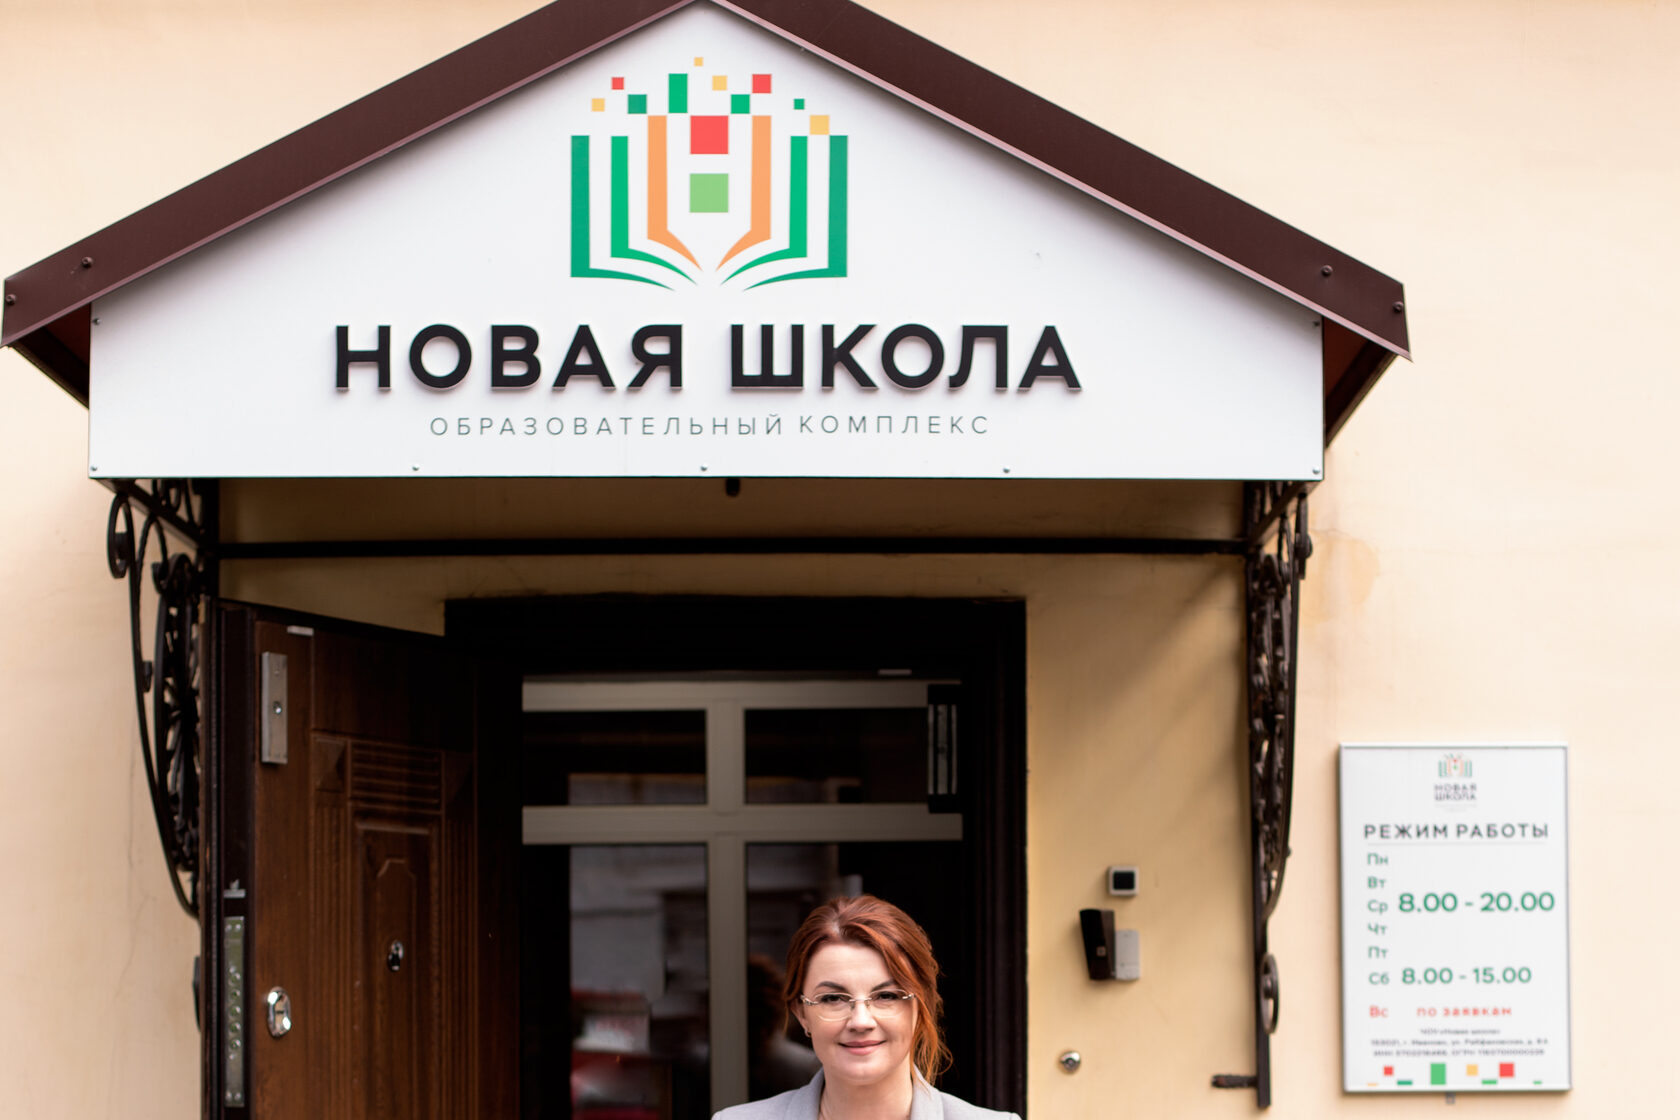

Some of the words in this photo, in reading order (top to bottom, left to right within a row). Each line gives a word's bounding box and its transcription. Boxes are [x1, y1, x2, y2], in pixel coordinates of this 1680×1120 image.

[335, 323, 683, 391] НОВАЯ
[730, 323, 1082, 391] ШКОЛА
[429, 413, 782, 437] ОБРАЗОВАТЕЛЬНЫЙ
[799, 414, 988, 435] КОМПЛЕКС
[1434, 783, 1477, 792] НОВАЯ
[1434, 791, 1477, 801] ШКОЛА
[1364, 824, 1449, 839] РЕЖИМ
[1456, 823, 1549, 838] РАБОТЫ
[1367, 852, 1389, 865] Пн
[1367, 876, 1386, 889] Вт
[1367, 899, 1389, 915] Ср
[1398, 892, 1459, 912] 8.00
[1480, 891, 1555, 912] 20.00
[1367, 923, 1387, 935] Чт
[1367, 946, 1388, 959] Пт
[1368, 971, 1390, 985] Сб
[1401, 967, 1453, 984] 8.00
[1473, 967, 1532, 984] 15.00
[1369, 1005, 1389, 1018] Вс
